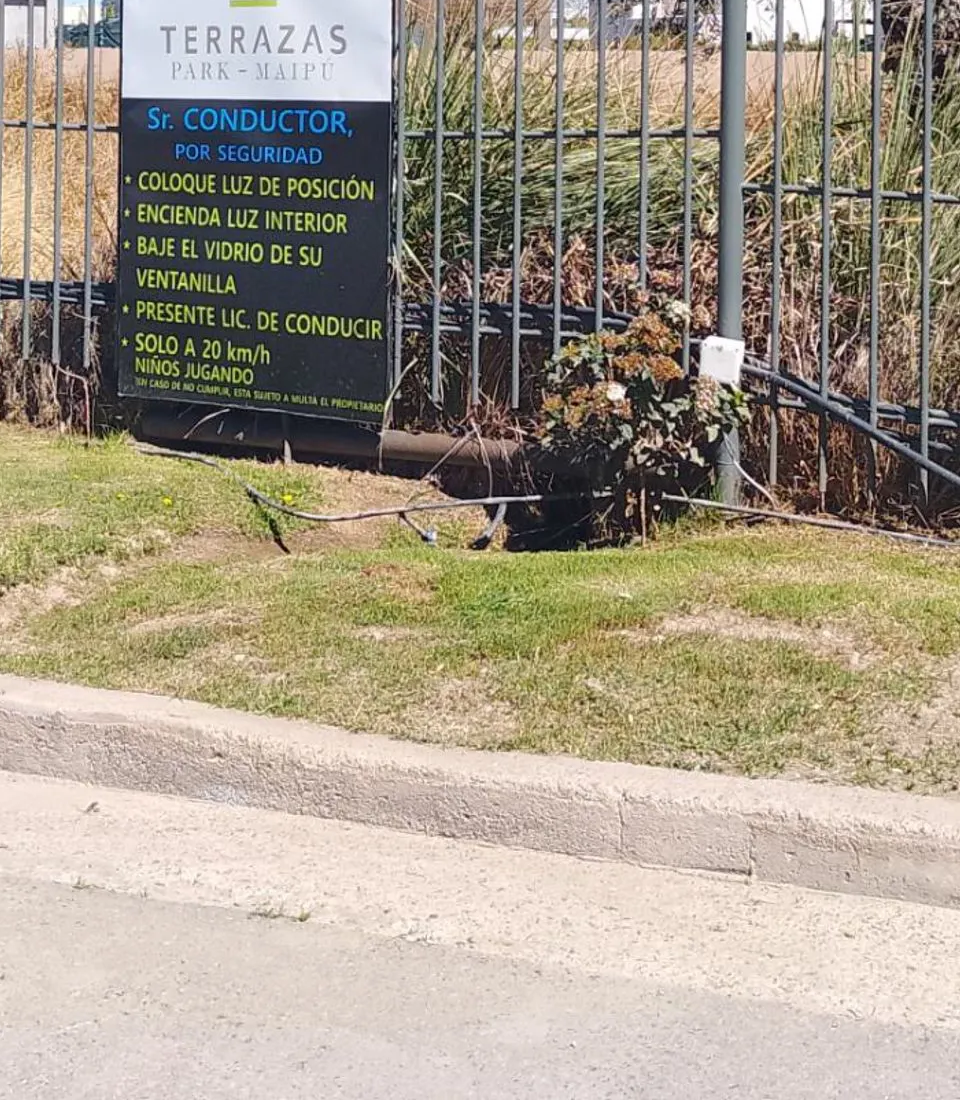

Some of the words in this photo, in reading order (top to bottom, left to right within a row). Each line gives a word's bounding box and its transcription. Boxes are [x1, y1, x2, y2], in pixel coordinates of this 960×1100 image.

[160, 24, 347, 55] TERRAZAS
[171, 61, 230, 80] PARK
[256, 57, 335, 81] MAIPÚ
[147, 107, 174, 130] Sr.
[183, 108, 354, 138] CONDUCTOR,
[175, 143, 211, 161] POR
[218, 145, 323, 165] SEGURIDAD
[138, 171, 217, 194] COLOQUE
[222, 174, 253, 194] LUZ
[259, 176, 281, 196] DE
[287, 174, 375, 200] POSICIÓN
[137, 204, 221, 228] ENCIENDA
[227, 208, 258, 230] LUZ
[265, 210, 348, 234] INTERIOR
[137, 236, 176, 258] BAJE
[182, 239, 199, 259] EL
[205, 240, 264, 264] VIDRIO
[270, 244, 293, 265] DE
[299, 245, 323, 267] SU
[136, 267, 237, 295] VENTANILLA
[136, 301, 215, 327] PRESENTE
[221, 309, 251, 330] LIC.
[257, 311, 279, 332] DE
[285, 313, 383, 341] CONDUCIR
[135, 332, 179, 355] SOLO
[184, 338, 196, 357] A
[202, 338, 221, 359] 20
[227, 340, 270, 366] km/h
[135, 355, 180, 378] NIÑOS
[184, 362, 254, 385] JUGANDO
[149, 379, 170, 389] CASO
[171, 381, 181, 390] DE
[183, 382, 195, 392] NO
[291, 394, 317, 406] MULTA
[320, 396, 329, 407] EL
[331, 398, 384, 413] PROPIETARIO
